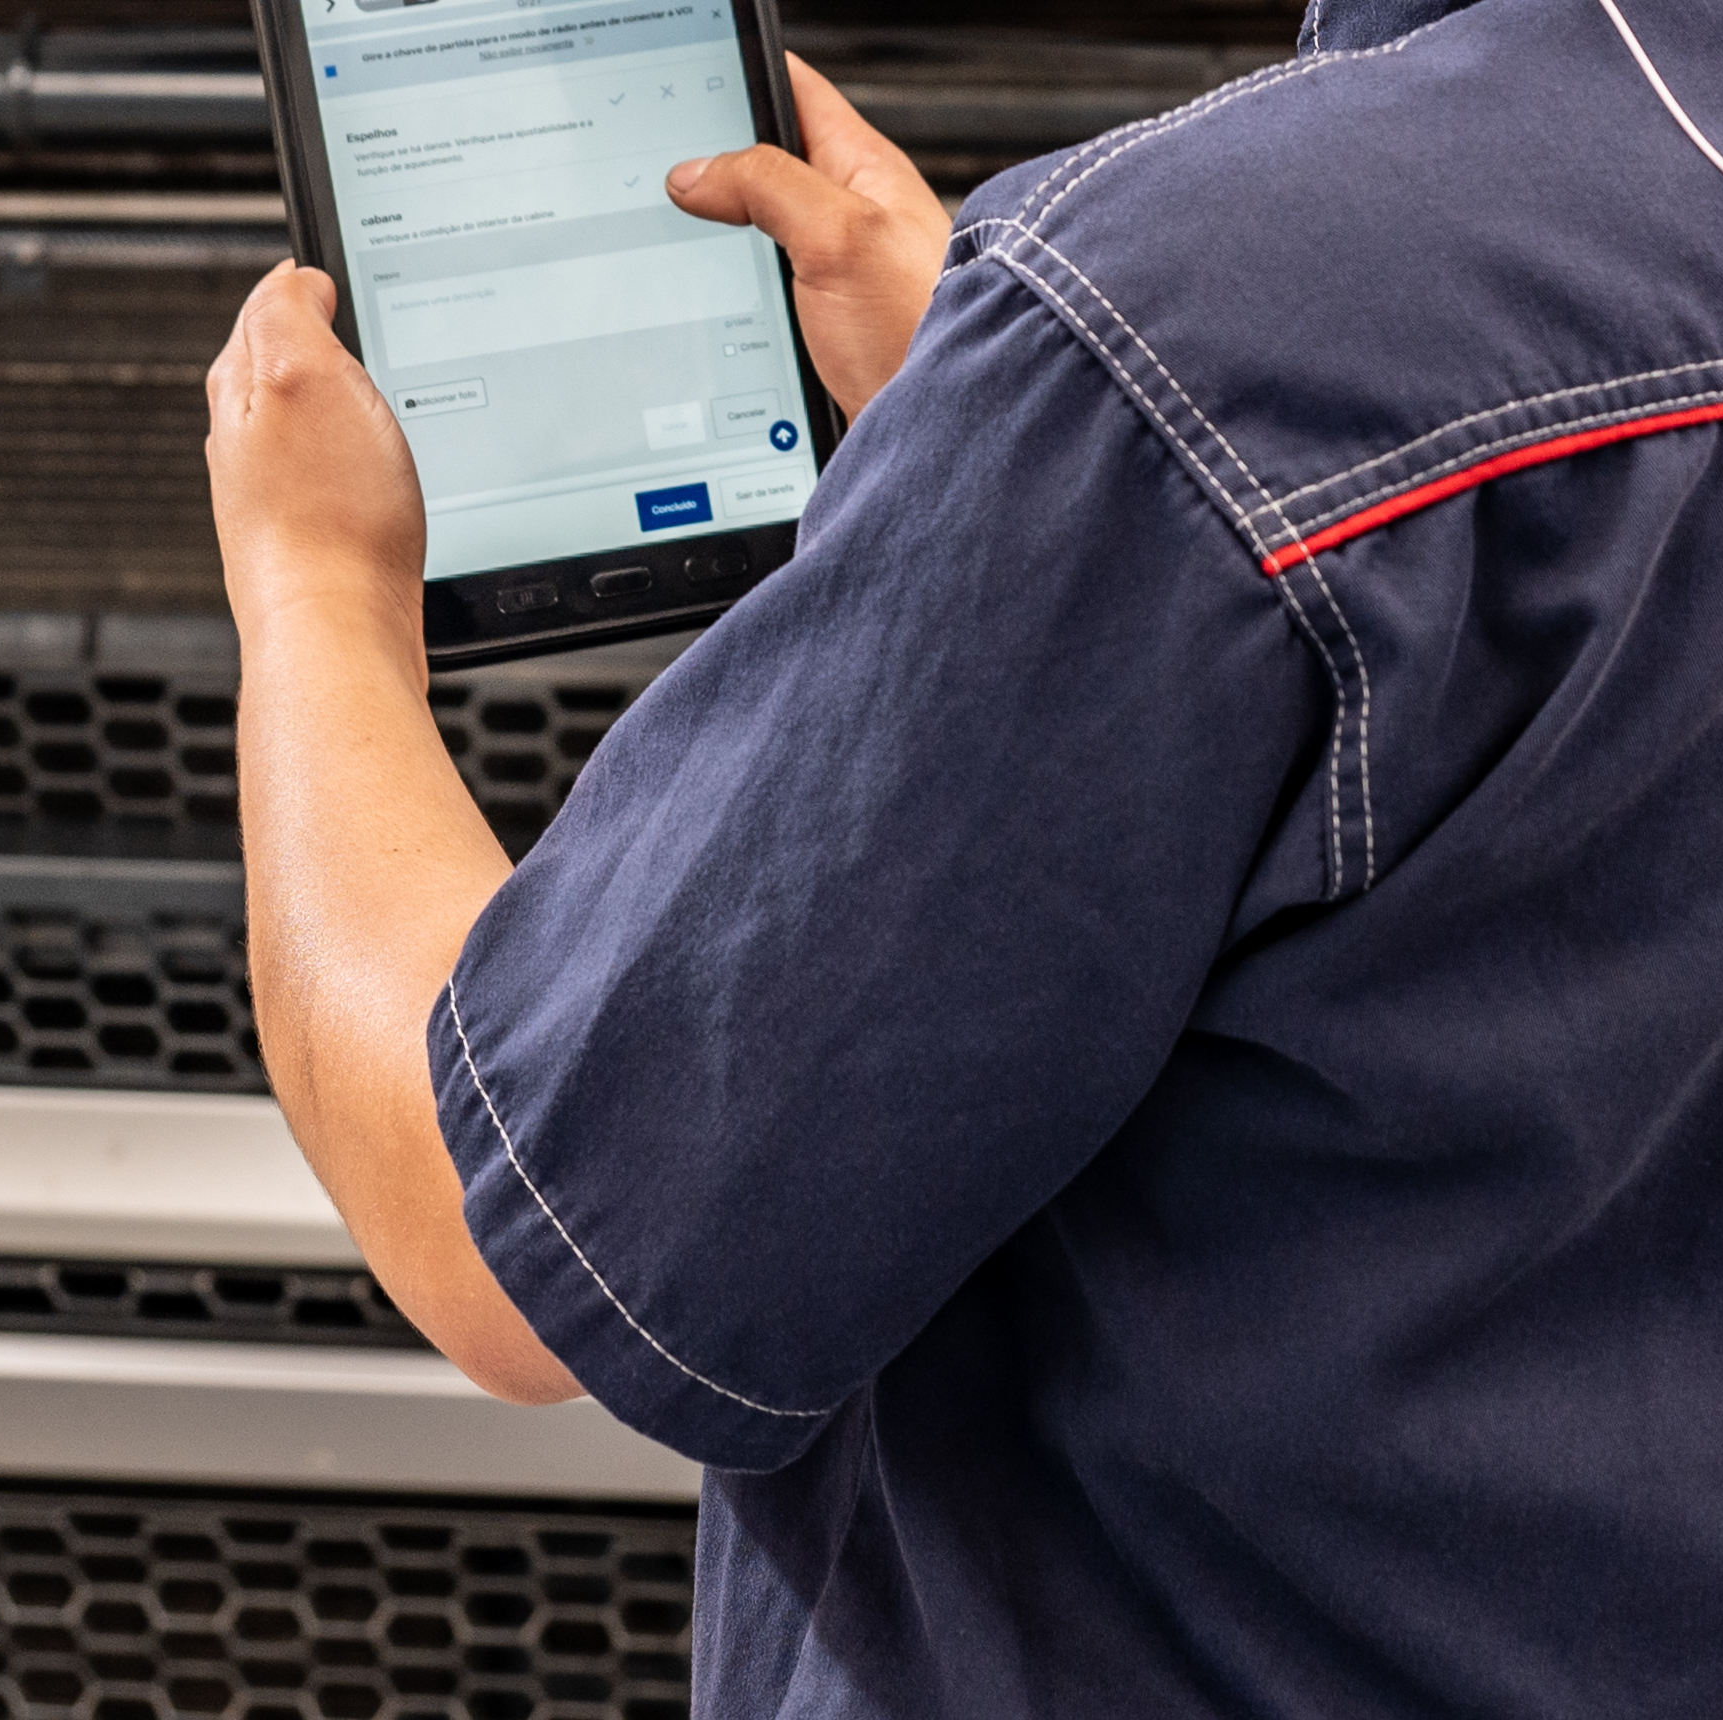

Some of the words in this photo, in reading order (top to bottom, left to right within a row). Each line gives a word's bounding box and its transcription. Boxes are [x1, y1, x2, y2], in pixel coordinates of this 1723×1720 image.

[362, 51, 384, 63] Gire
[385, 51, 392, 59] a
[393, 46, 423, 58] chave
[425, 44, 438, 54] de
[440, 38, 475, 53] partida
[476, 36, 499, 48] para
[508, 29, 536, 41] modo
[538, 26, 551, 36] de
[552, 22, 578, 34] rádio
[579, 19, 607, 30] antes
[608, 16, 621, 26] de
[622, 10, 665, 24] conectar
[478, 49, 498, 60] Não
[499, 45, 523, 57] exibir
[525, 39, 574, 54] novamente
[346, 127, 398, 143] Espelhos
[354, 147, 395, 163] Verifique
[397, 147, 408, 156] se
[410, 143, 422, 154] há
[455, 133, 496, 147] Verifique
[497, 131, 514, 140] sua
[357, 163, 389, 177] função
[391, 161, 402, 172] de
[361, 212, 403, 227] cabana
[368, 231, 410, 246] Verifique
[420, 223, 461, 239] condição
[463, 221, 475, 231] do
[476, 216, 509, 229] interior
[511, 214, 523, 224] da
[416, 393, 456, 406] Adicionar
[458, 390, 477, 400] foto
[727, 408, 766, 421] Cancelar
[736, 489, 754, 500] Sair
[755, 487, 767, 498] da
[769, 484, 794, 495] tarefa
